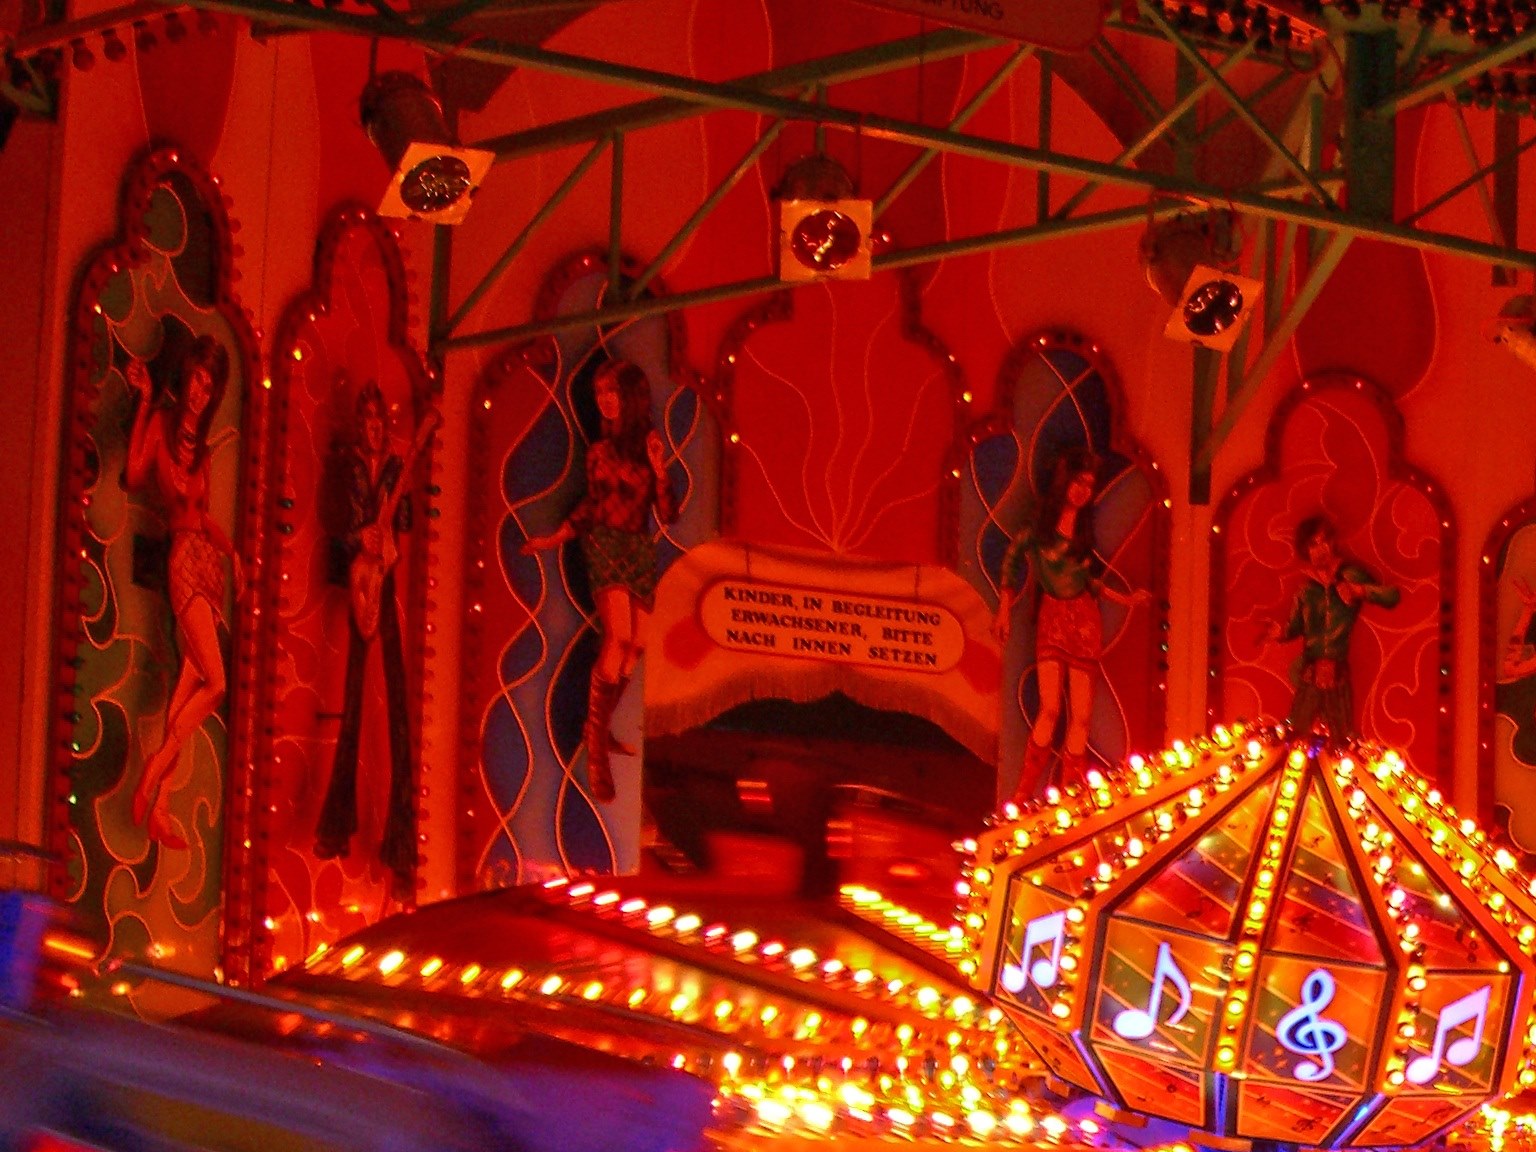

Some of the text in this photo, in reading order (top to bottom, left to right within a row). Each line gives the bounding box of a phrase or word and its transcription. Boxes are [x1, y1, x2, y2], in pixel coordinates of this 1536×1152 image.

[724, 587, 942, 626] KINDER, IN BEGLEITUNG
[731, 608, 934, 646] ERWACHSENER, BITTE
[726, 629, 938, 666] NACH INNEN SETZEN
